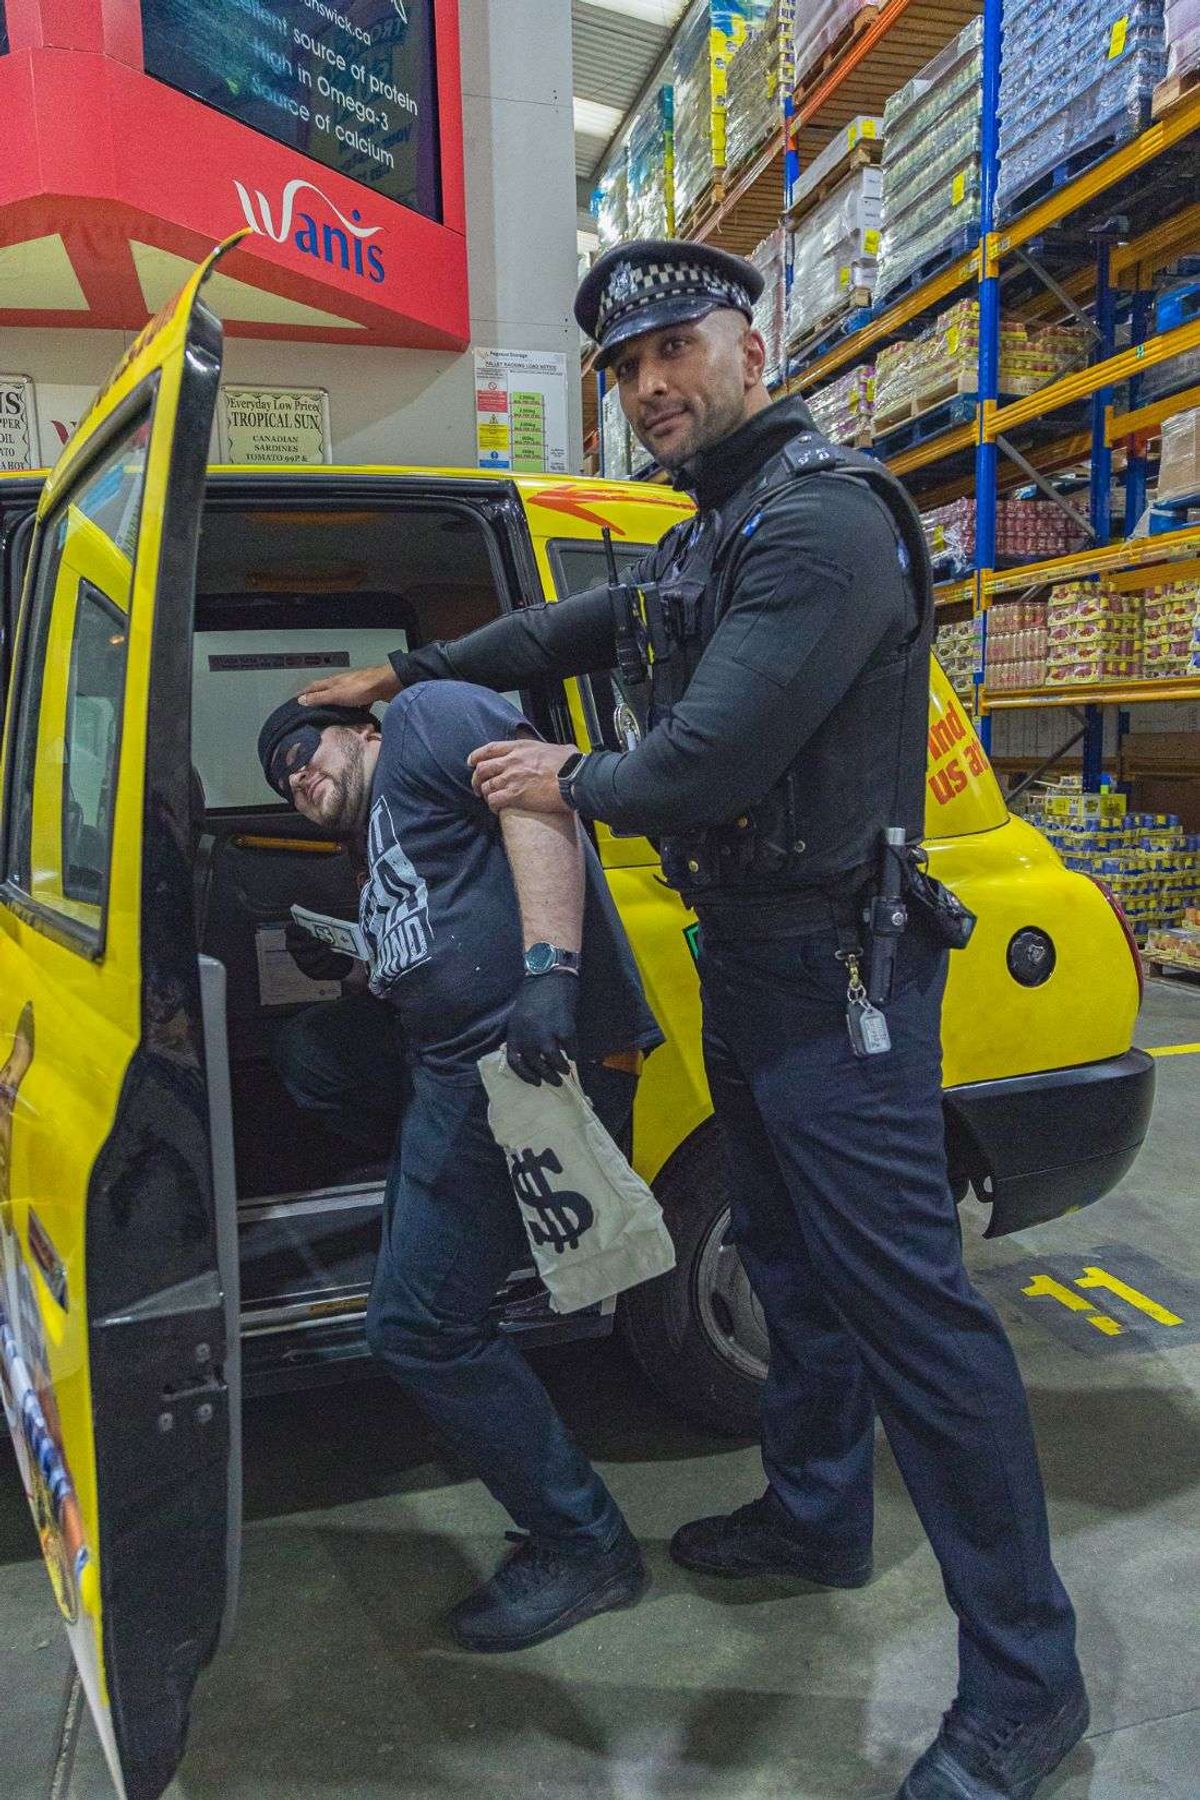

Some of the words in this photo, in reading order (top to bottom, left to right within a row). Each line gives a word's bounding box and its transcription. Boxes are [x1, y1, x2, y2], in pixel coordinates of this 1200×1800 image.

[293, 27, 347, 71] source
[351, 64, 366, 83] of
[370, 74, 418, 116] protein
[297, 63, 312, 88] in
[317, 76, 389, 131] Omega-3
[315, 114, 330, 134] of
[335, 125, 394, 169] calcium
[232, 179, 386, 283] Wanis
[230, 398, 270, 412] Everyday
[274, 399, 292, 410] Low
[231, 411, 293, 428] TROPICAL
[295, 412, 320, 430] SUN
[254, 444, 298, 452] SARDINES
[927, 758, 968, 805] us
